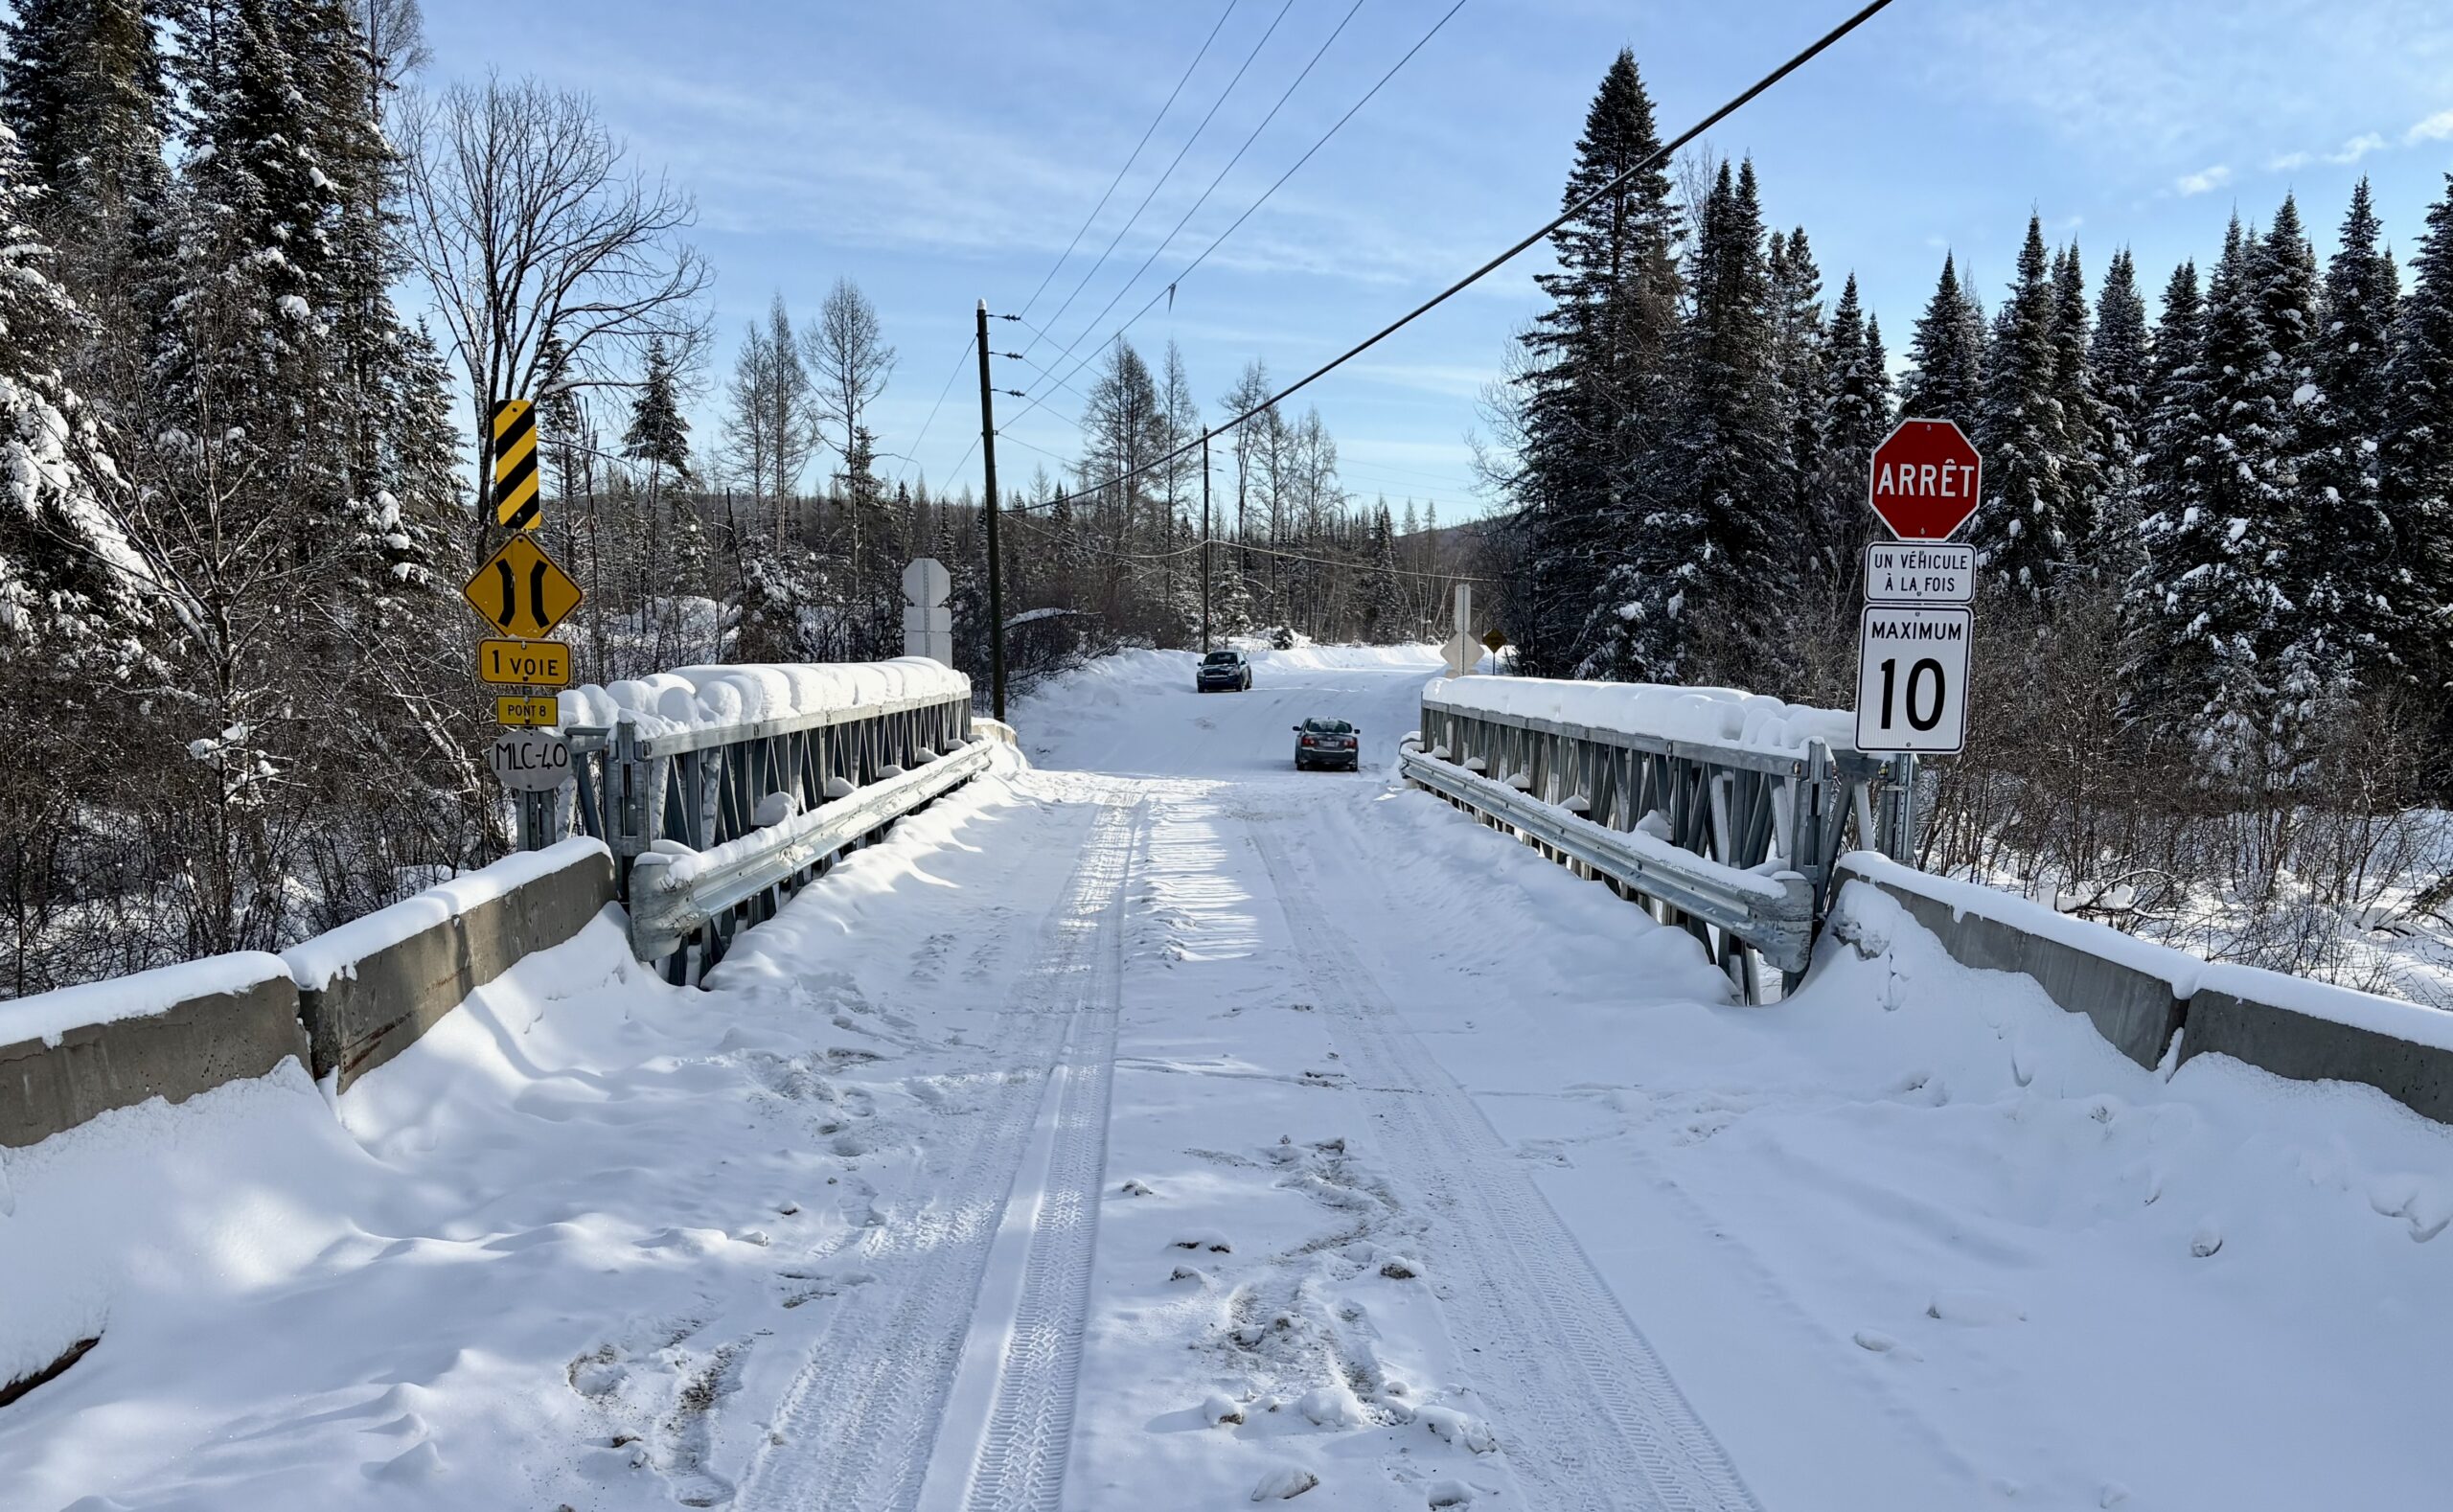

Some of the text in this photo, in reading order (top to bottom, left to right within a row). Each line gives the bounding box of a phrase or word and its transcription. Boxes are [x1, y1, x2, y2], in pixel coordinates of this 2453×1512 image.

[1876, 458, 1975, 498] ARRÊT
[1874, 550, 1968, 570] UN VÉHICULE
[1885, 572, 1955, 592] À LA FOIS
[1871, 621, 1962, 641] MAXIMUM
[492, 650, 559, 676] 1 VOIE
[1880, 657, 1946, 732] 10
[507, 704, 546, 717] PONT 8
[495, 742, 568, 771] MLC-40
